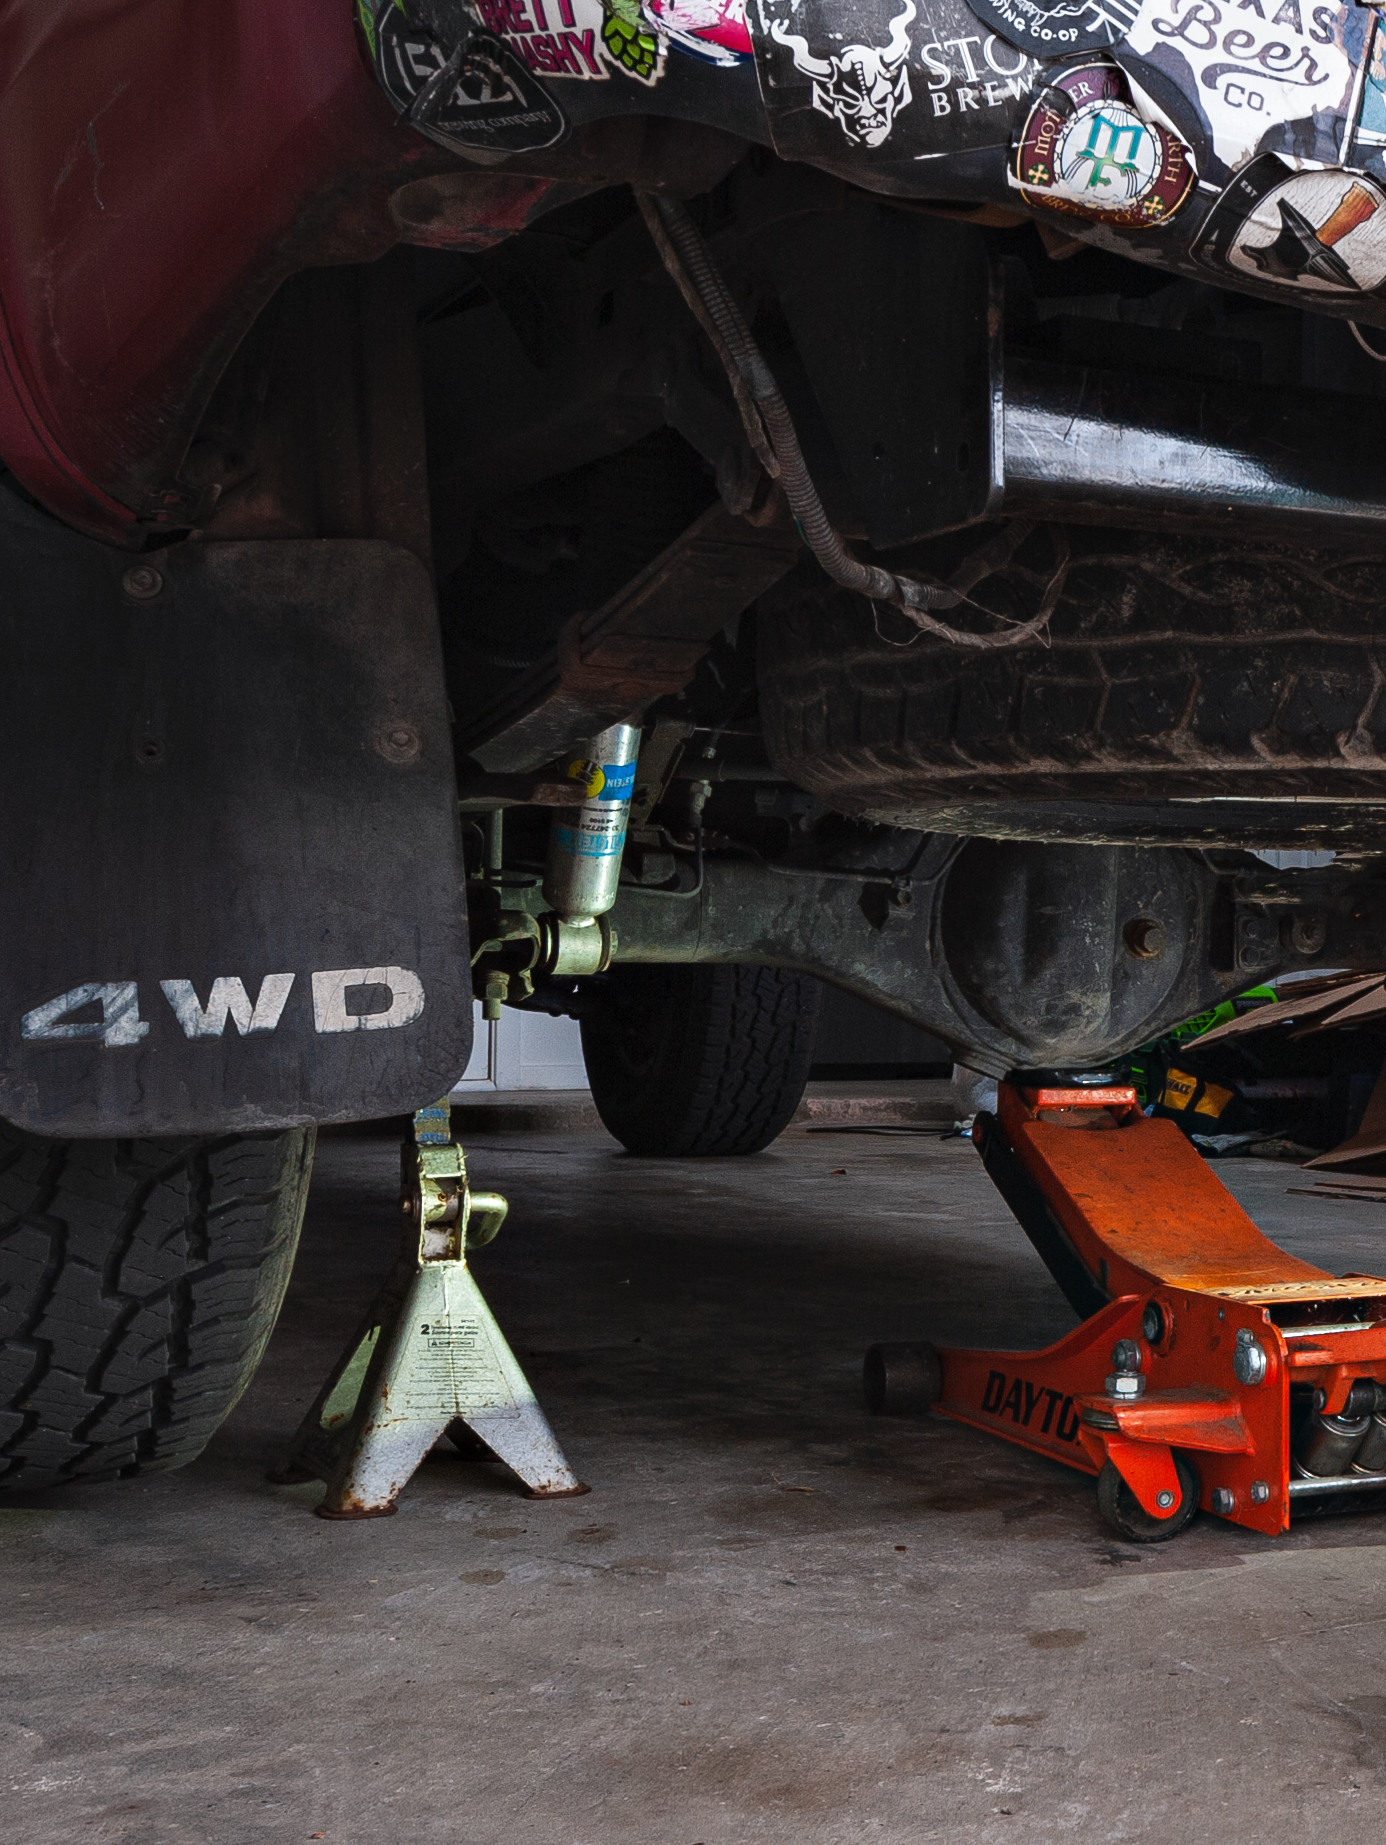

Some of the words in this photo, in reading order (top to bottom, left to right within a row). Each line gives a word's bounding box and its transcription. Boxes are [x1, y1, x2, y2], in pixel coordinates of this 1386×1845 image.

[920, 34, 1043, 91] STO
[1151, 0, 1330, 87] Beer
[490, 110, 552, 129] company
[1223, 82, 1271, 116] CO.
[20, 966, 425, 1047] 4WD
[421, 1323, 430, 1335] 2
